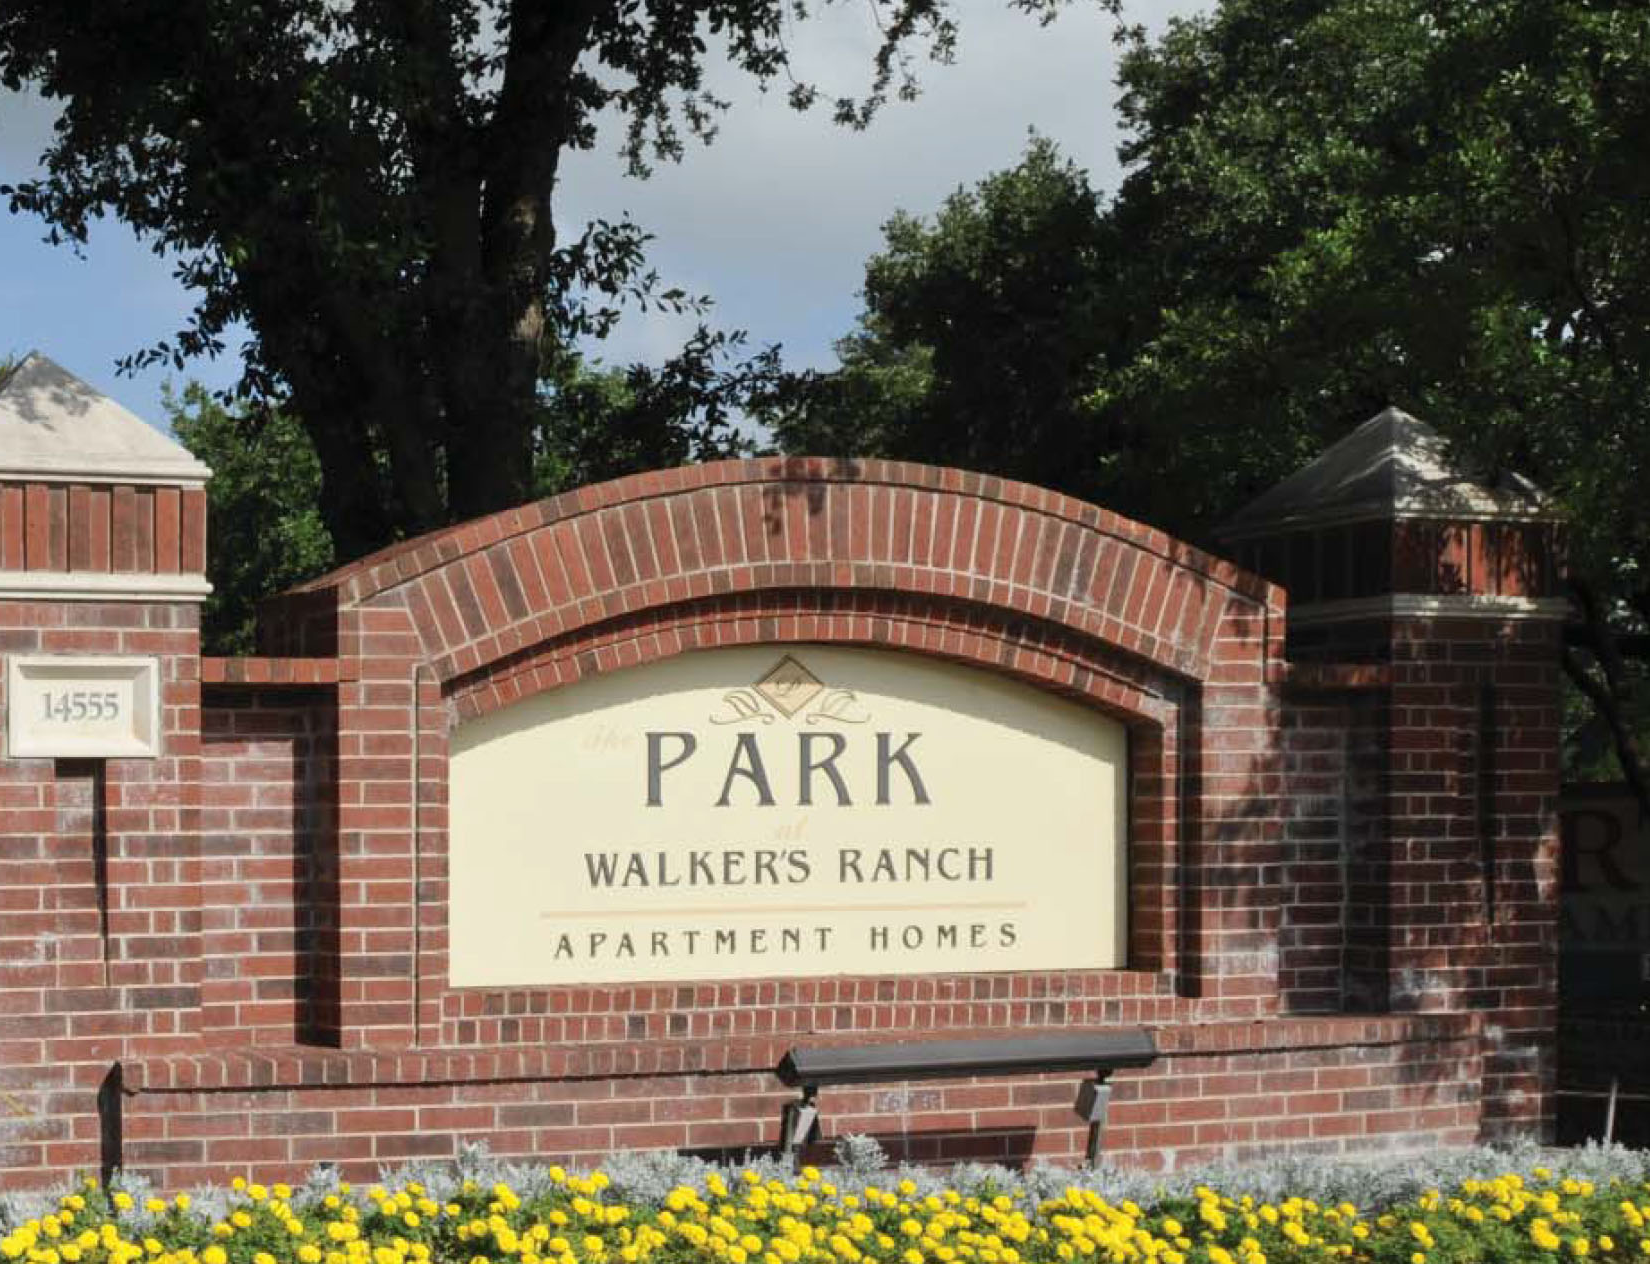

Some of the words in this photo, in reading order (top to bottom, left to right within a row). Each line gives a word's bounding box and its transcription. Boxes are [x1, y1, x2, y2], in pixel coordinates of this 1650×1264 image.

[42, 692, 119, 722] 14555
[645, 731, 931, 808] PARK
[583, 849, 811, 888] WALKER'S
[839, 847, 994, 883] RANCH
[553, 927, 832, 959] APARTMENT
[870, 923, 1017, 951] HOMES
